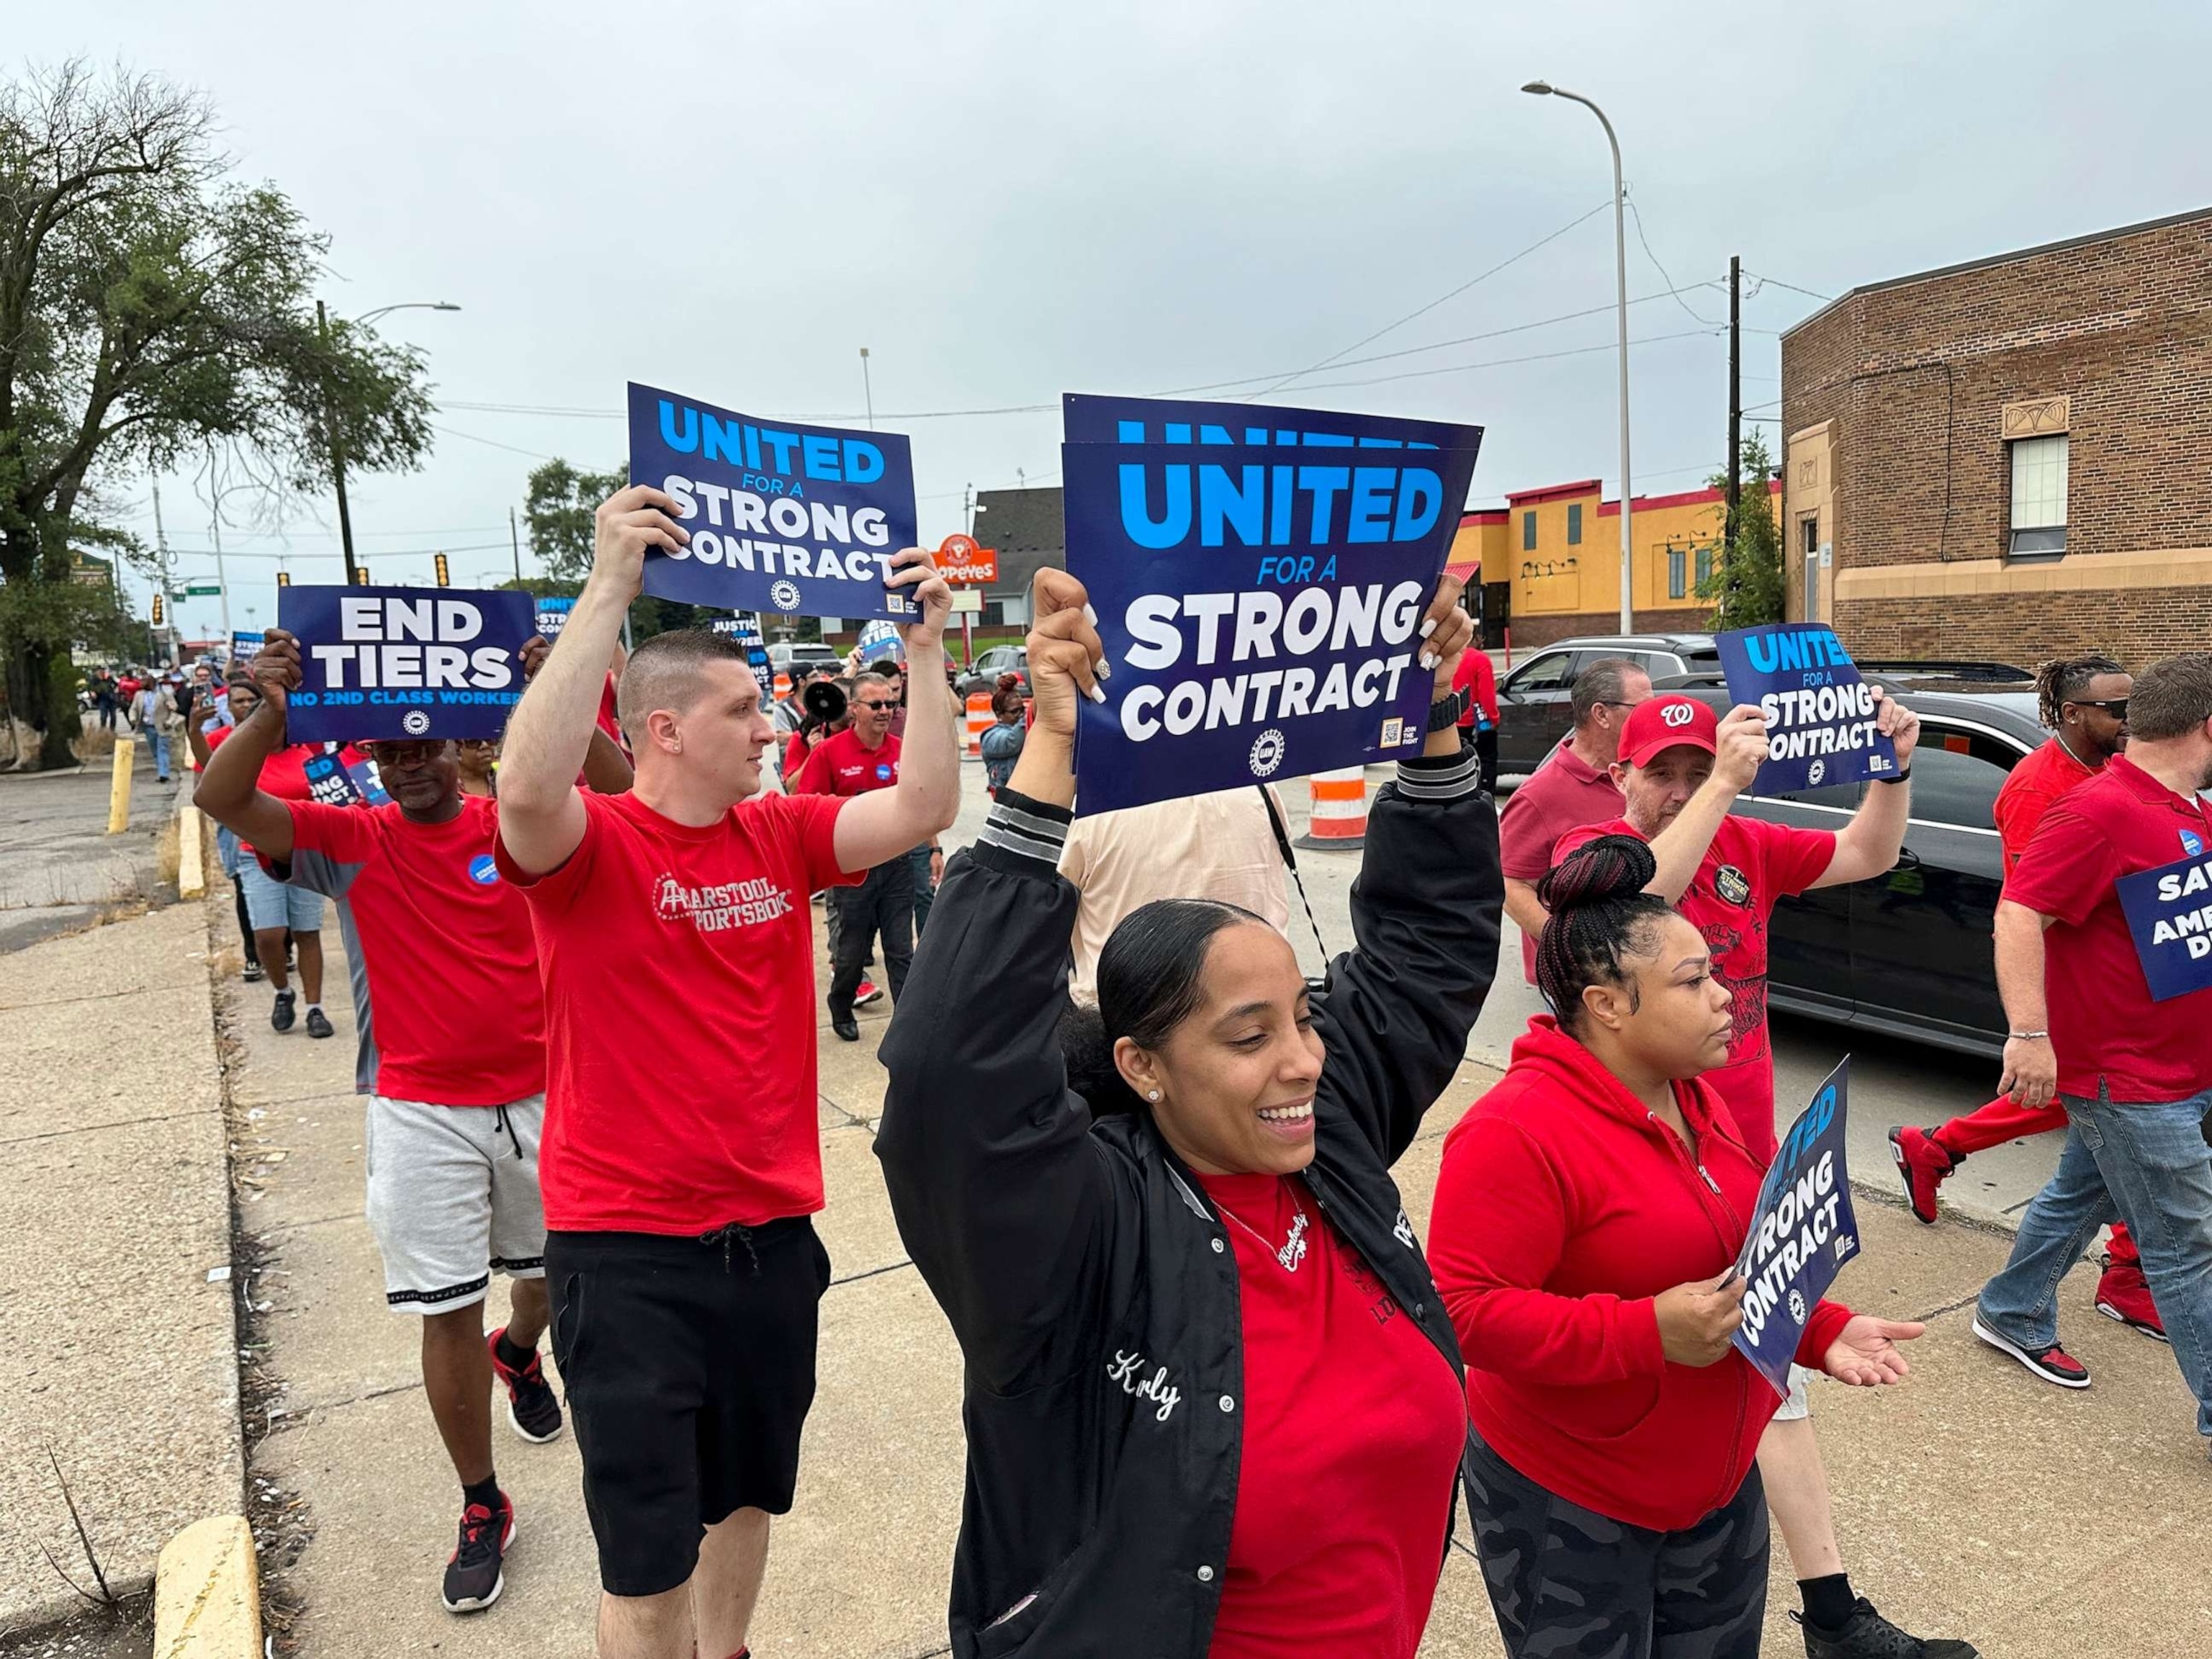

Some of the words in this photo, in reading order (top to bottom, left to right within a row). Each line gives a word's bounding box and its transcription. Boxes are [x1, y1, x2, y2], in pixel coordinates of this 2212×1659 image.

[658, 400, 886, 483] UNITED
[742, 472, 783, 495] FOR
[791, 481, 804, 498] A
[1118, 464, 1442, 549] UNITED
[663, 475, 890, 547] STRONG
[1257, 556, 1314, 585] FOR
[1318, 554, 1337, 581] A
[341, 597, 482, 642] END
[1124, 580, 1423, 670] STRONG
[311, 645, 512, 689] TIERS
[1744, 631, 1853, 673] UNITE
[290, 691, 318, 707] NO
[323, 691, 364, 706] 2ND
[370, 691, 433, 705] CLASS
[1120, 654, 1412, 742] CONTRACT
[1803, 672, 1824, 687] FOR
[1825, 671, 1833, 684] A
[1660, 702, 1694, 727] W
[1761, 682, 1874, 729] STRONG
[1259, 747, 1275, 759] UAW
[1769, 721, 1878, 761] ONTRACT
[2186, 930, 2212, 960] D
[1745, 1151, 1833, 1280] TRONG
[1740, 1192, 1840, 1347] CONTRACT
[1107, 1349, 1181, 1421] Krly
